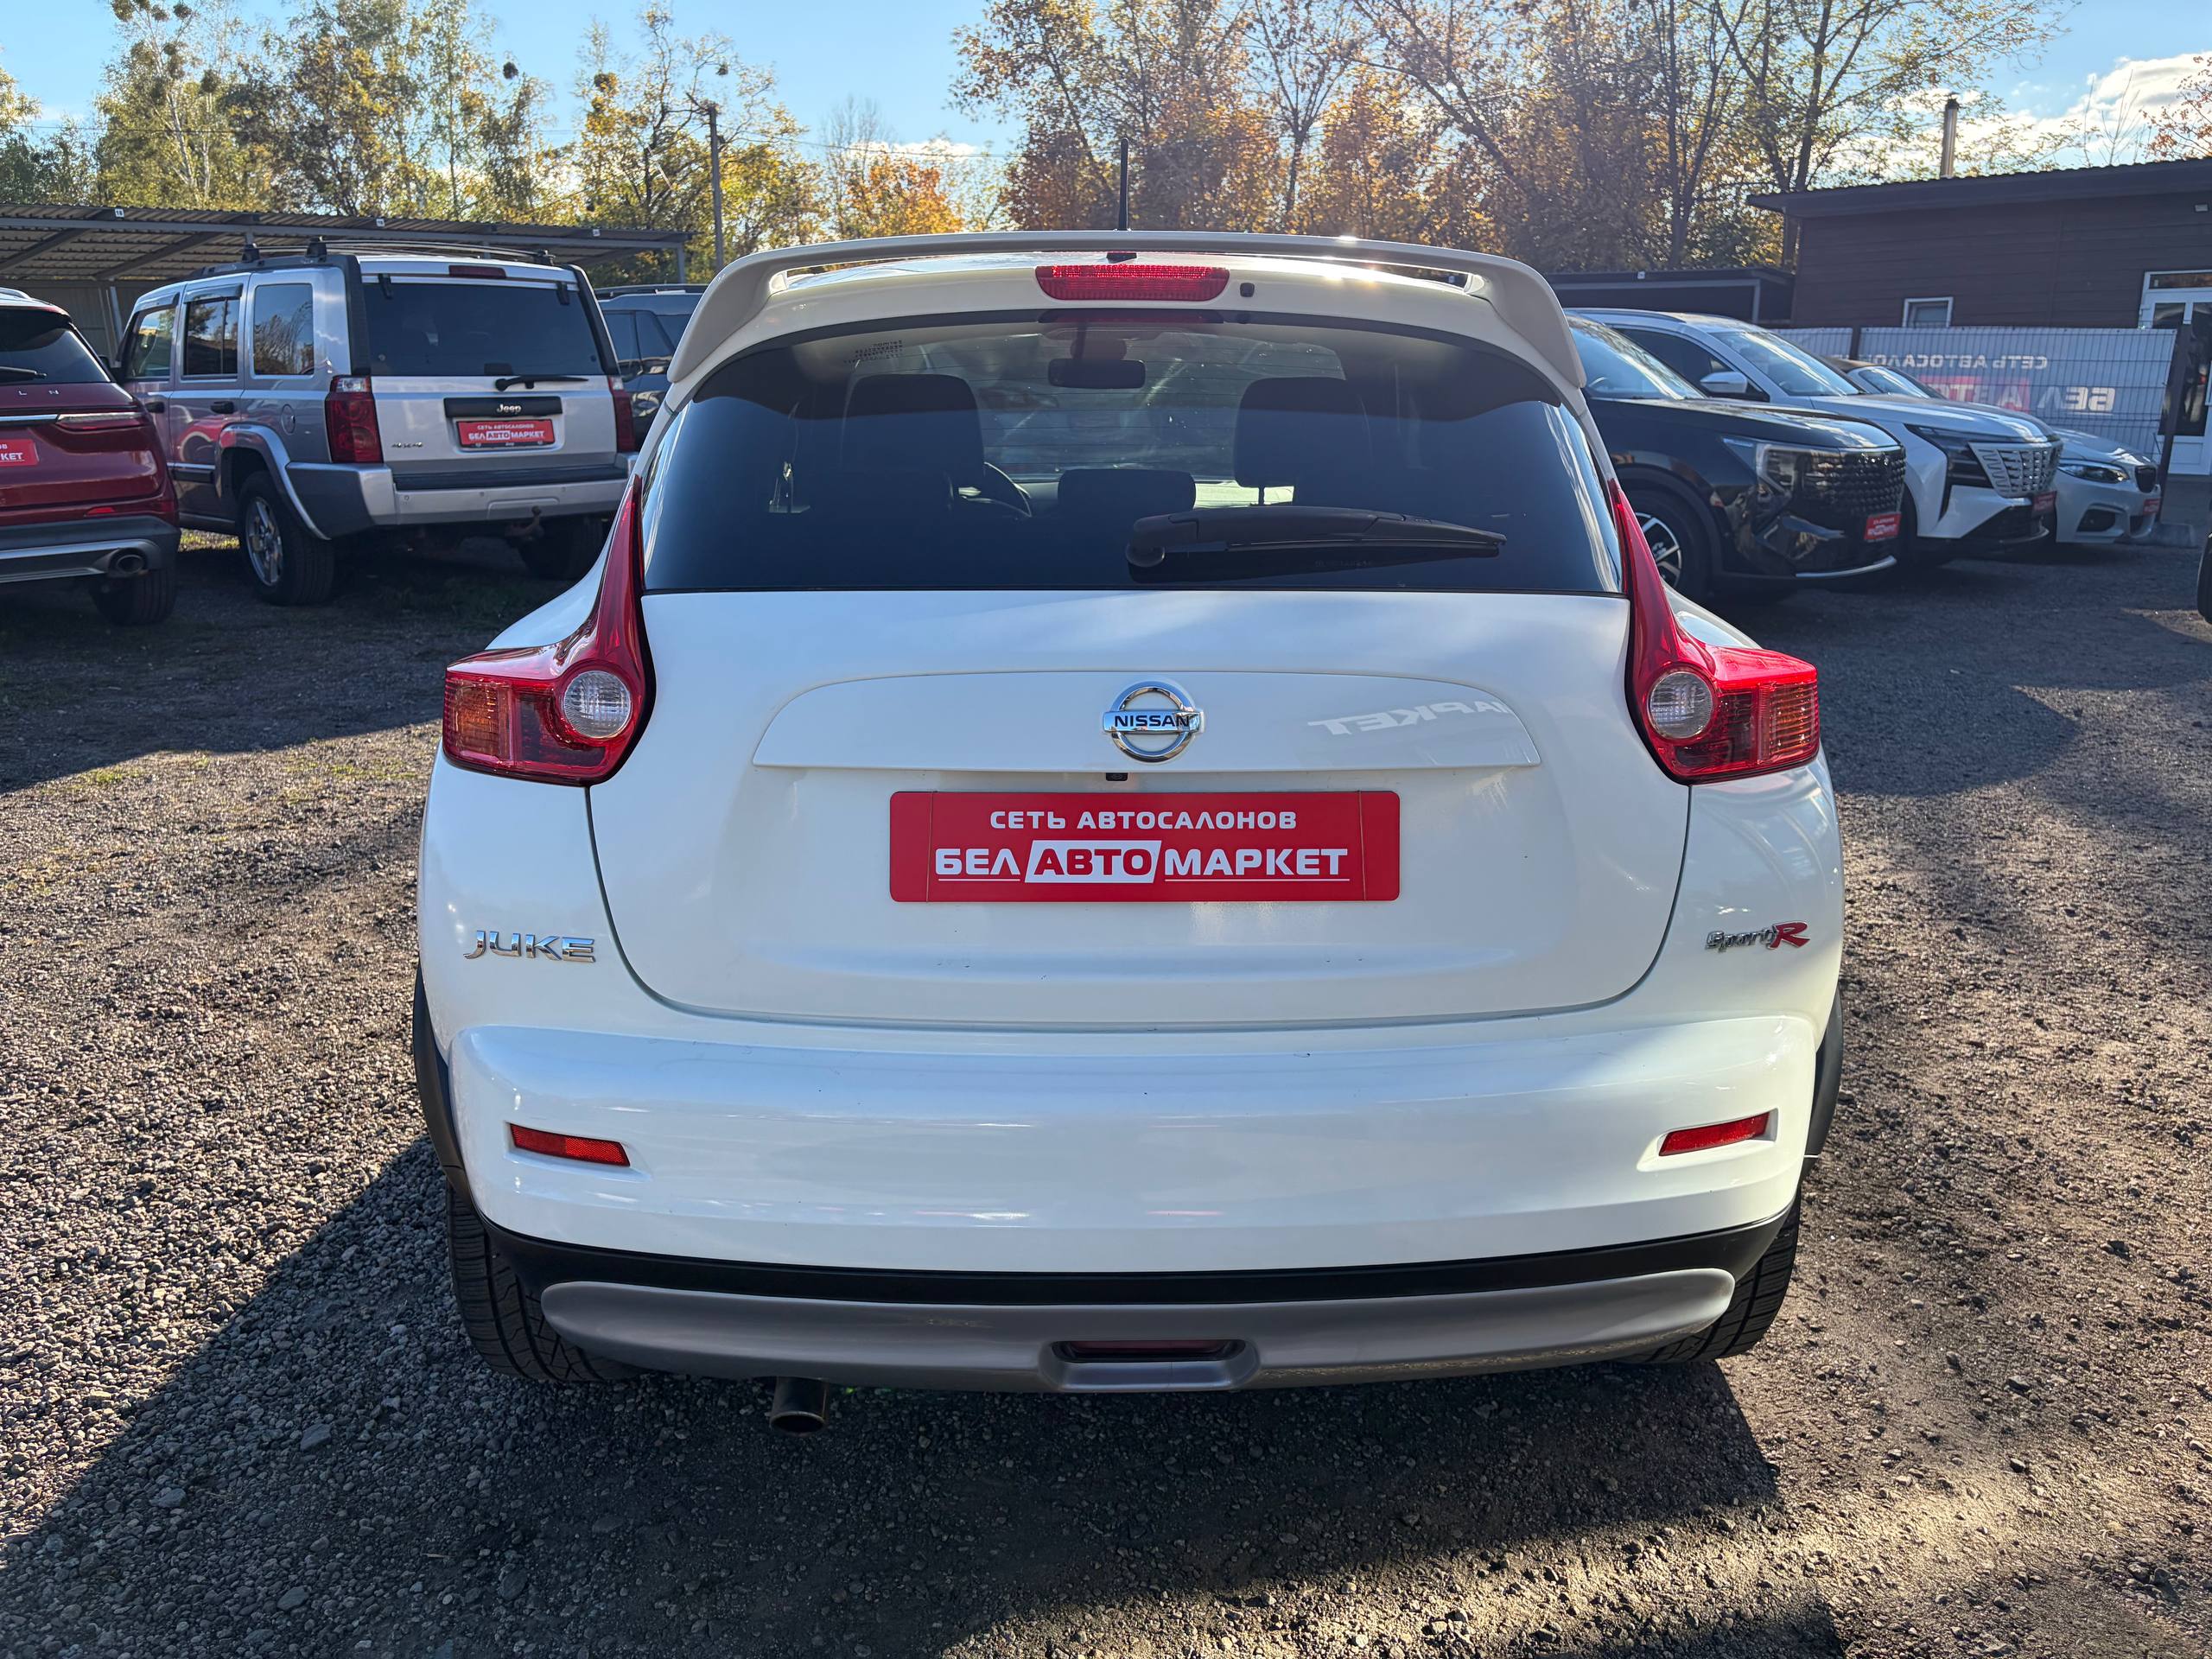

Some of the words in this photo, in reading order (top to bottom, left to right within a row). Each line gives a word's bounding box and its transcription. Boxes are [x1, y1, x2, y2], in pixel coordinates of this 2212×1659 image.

[497, 404, 522, 415] Jeep
[1115, 715, 1190, 727] NISSAN
[990, 811, 1066, 830] СЕТЬ
[1077, 811, 1297, 830] АВТОСАЛОНОВ
[462, 930, 596, 963] JUKE
